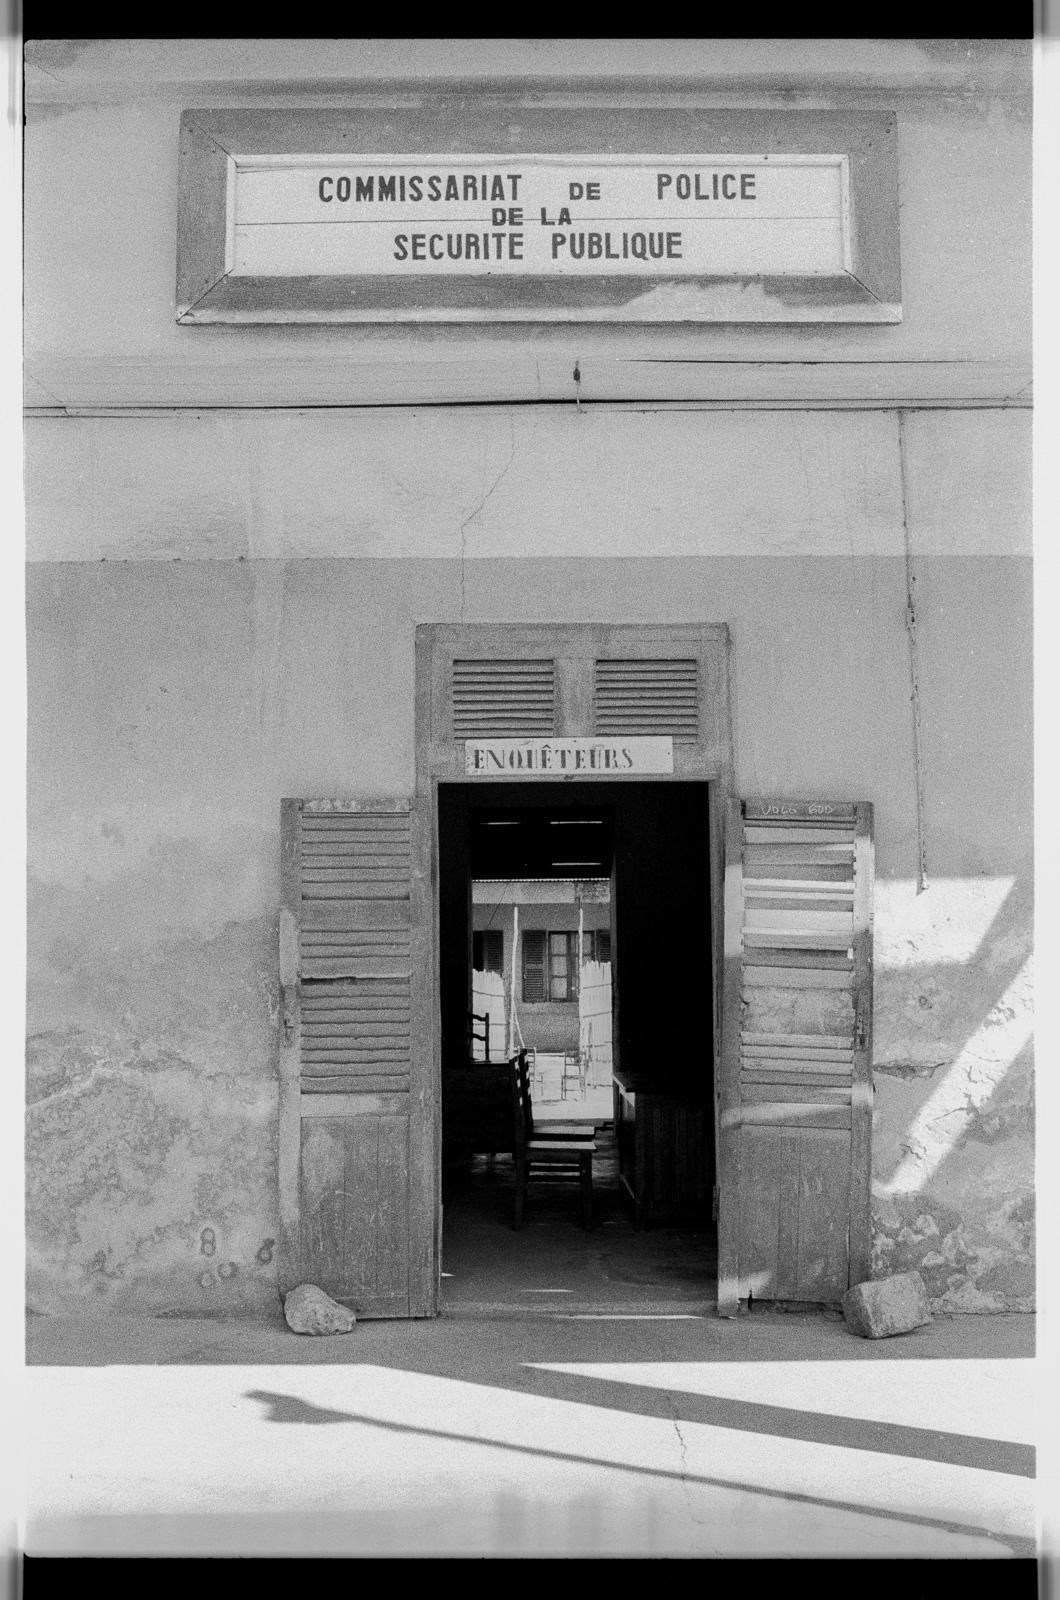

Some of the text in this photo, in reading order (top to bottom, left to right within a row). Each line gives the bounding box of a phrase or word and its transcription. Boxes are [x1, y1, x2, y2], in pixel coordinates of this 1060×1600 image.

[318, 173, 756, 203] COMMISSARIAT DE POLICE
[492, 207, 572, 226] DE LA
[393, 232, 682, 262] SECURITE PUBLIQUE
[474, 743, 633, 770] ENQUÊTEURS
